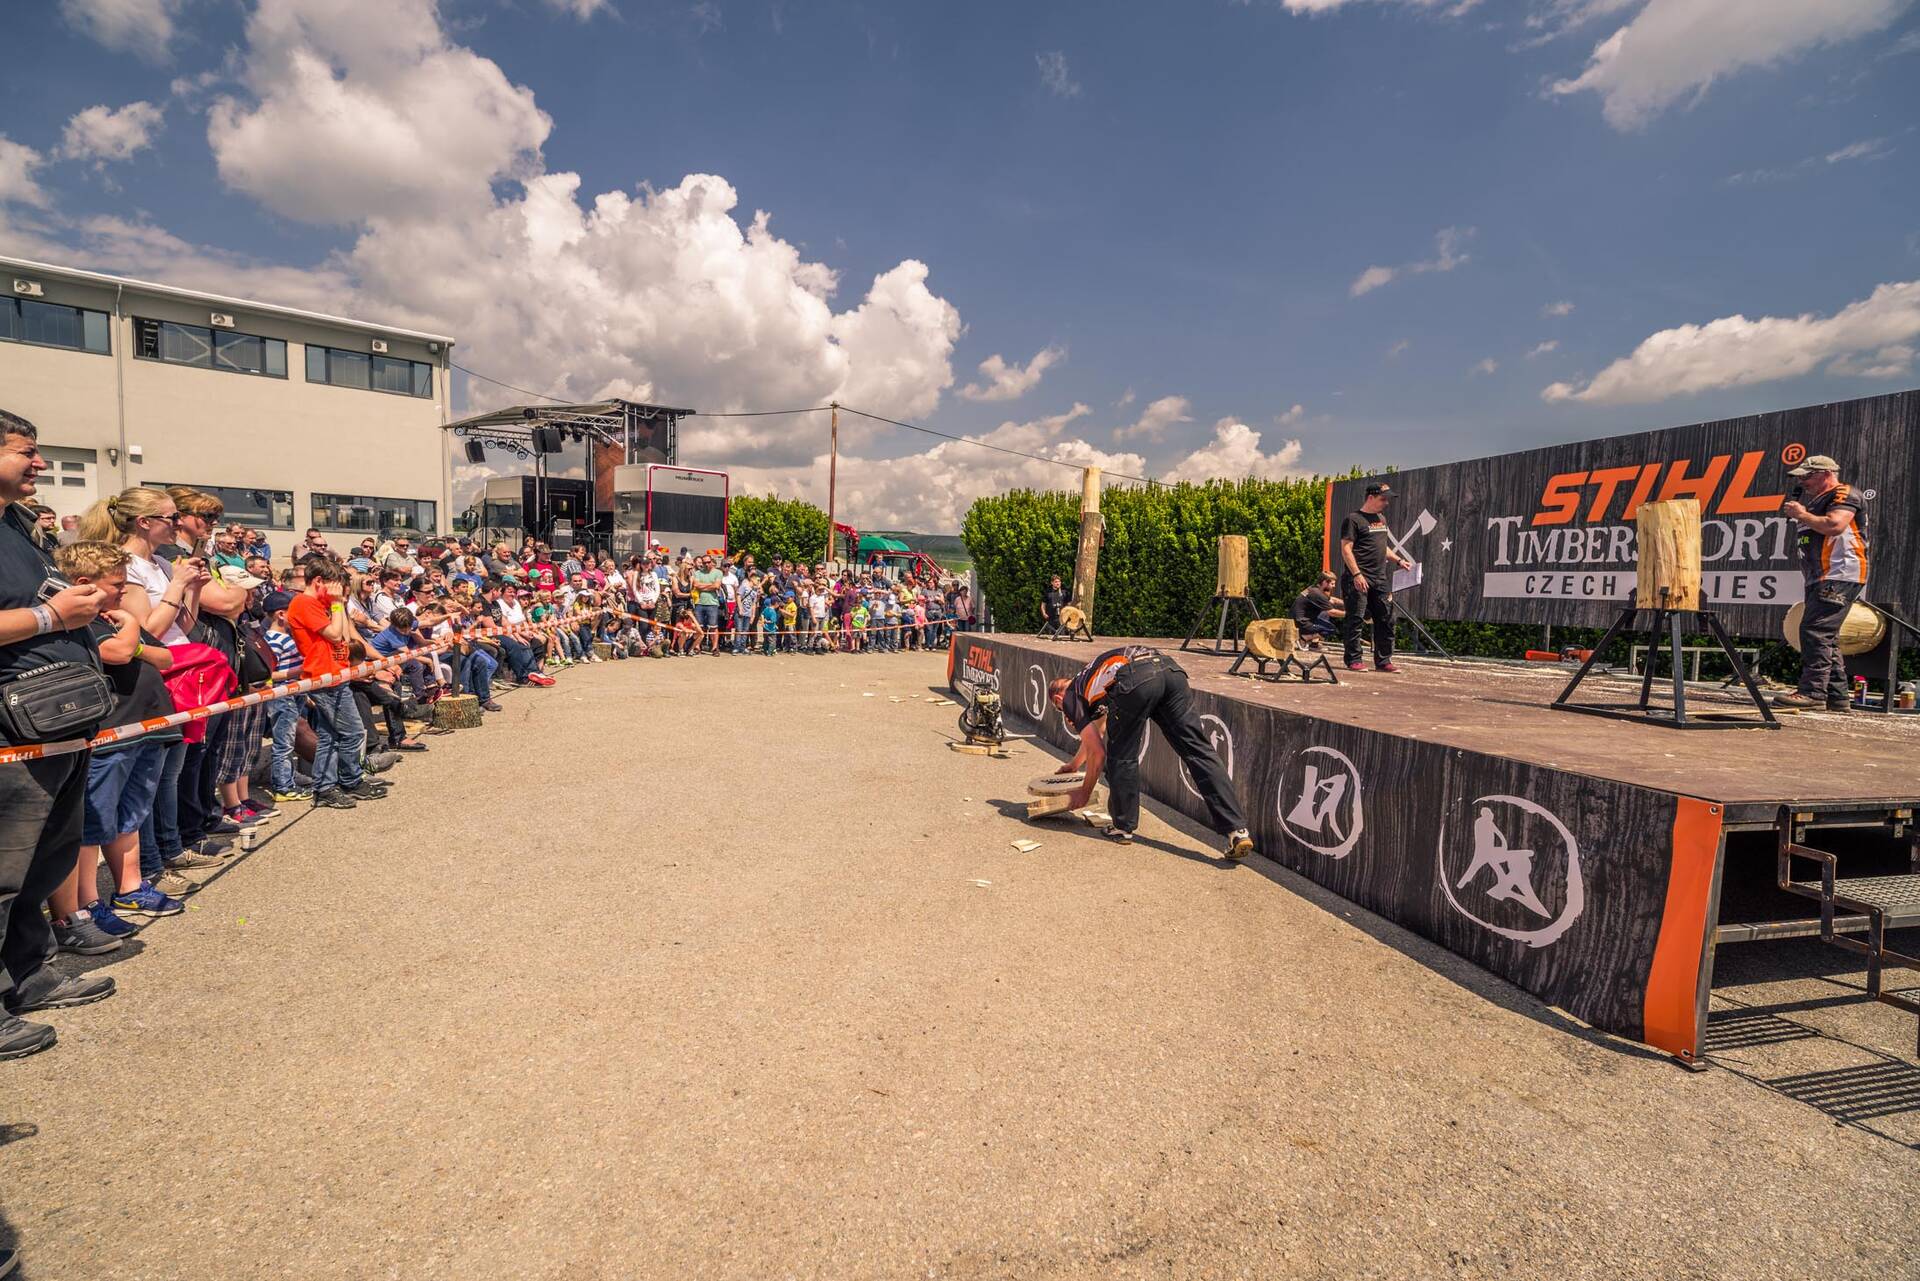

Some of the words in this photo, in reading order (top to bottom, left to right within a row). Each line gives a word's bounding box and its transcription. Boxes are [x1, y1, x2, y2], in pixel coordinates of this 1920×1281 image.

[1532, 450, 1786, 526] STIHL
[1525, 575, 1617, 597] CZECH
[968, 645, 993, 673] STIHL
